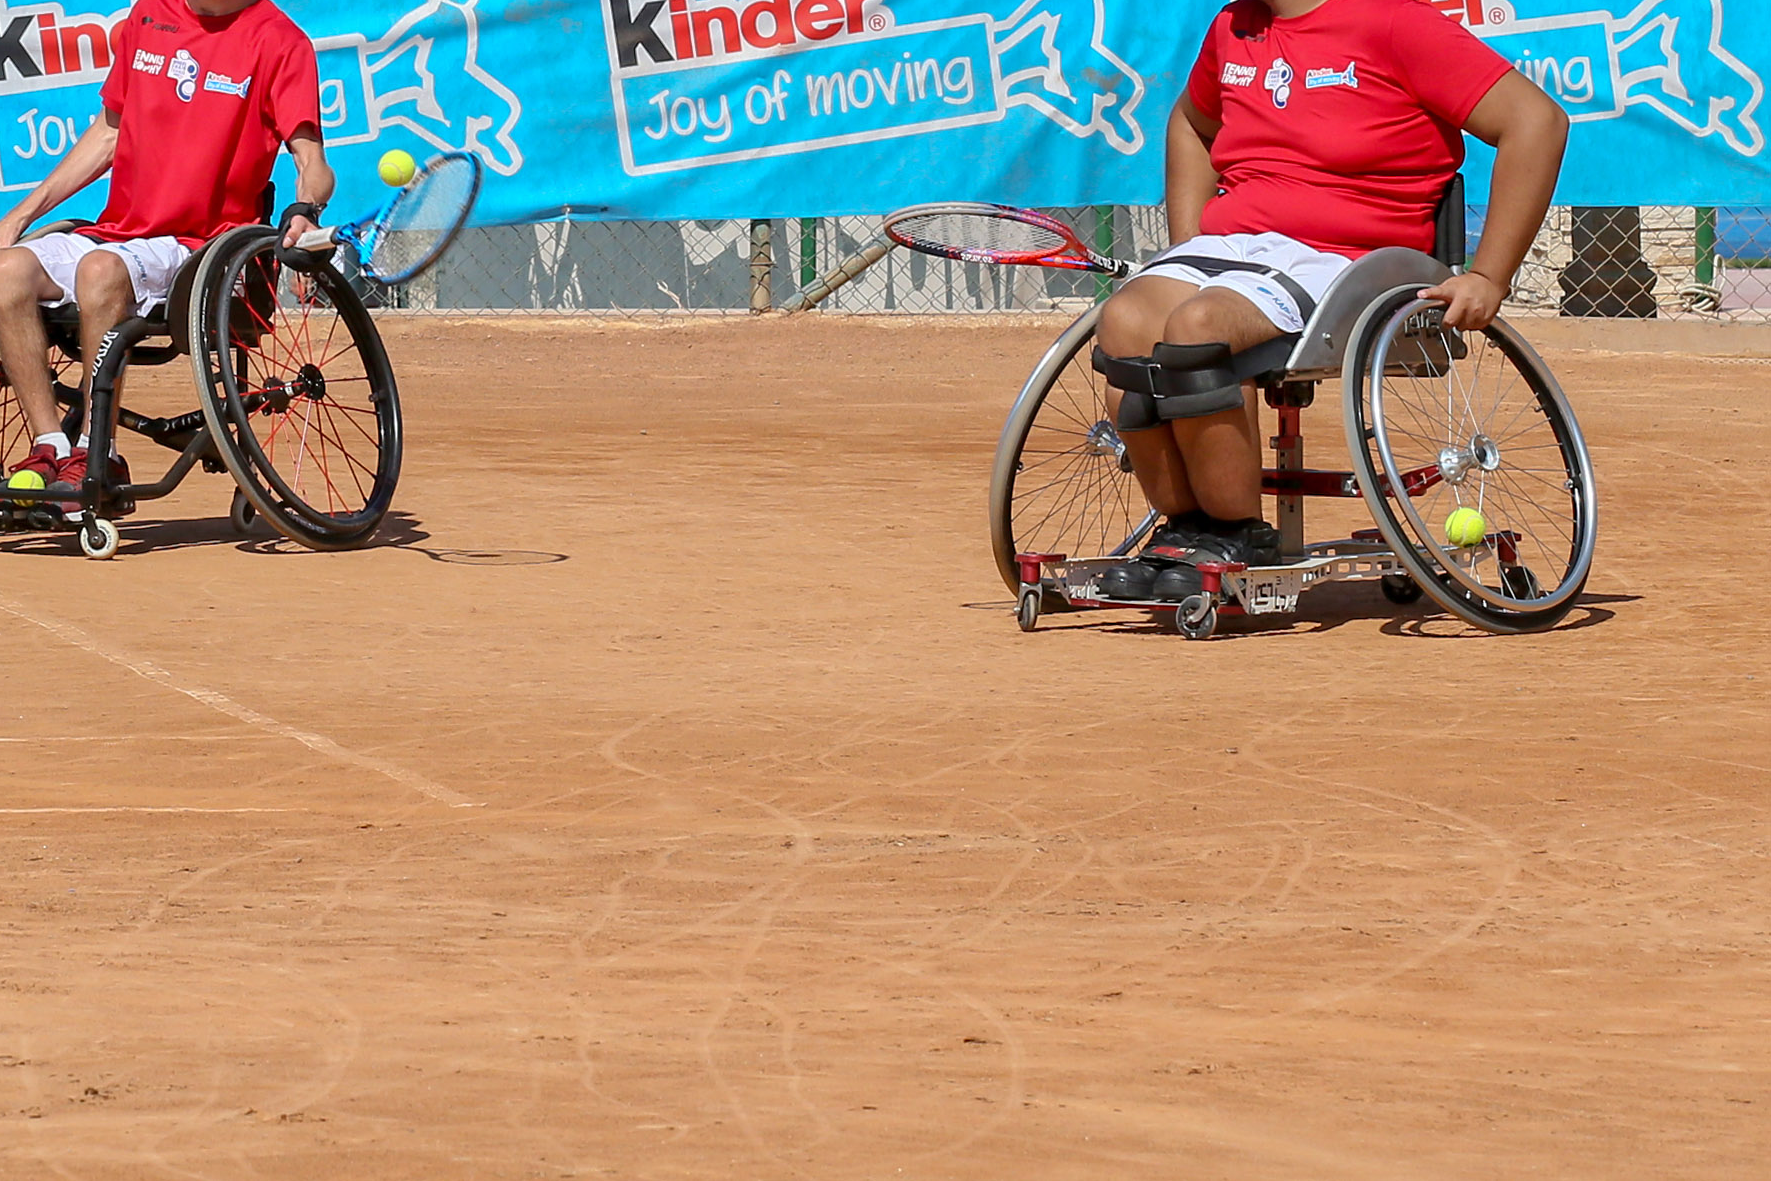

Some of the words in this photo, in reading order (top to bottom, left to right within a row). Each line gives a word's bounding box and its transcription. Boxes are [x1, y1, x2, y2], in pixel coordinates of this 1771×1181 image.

[134, 49, 166, 66] ENNIS
[644, 89, 733, 144] Joy
[744, 69, 792, 125] of
[805, 51, 974, 117] moving
